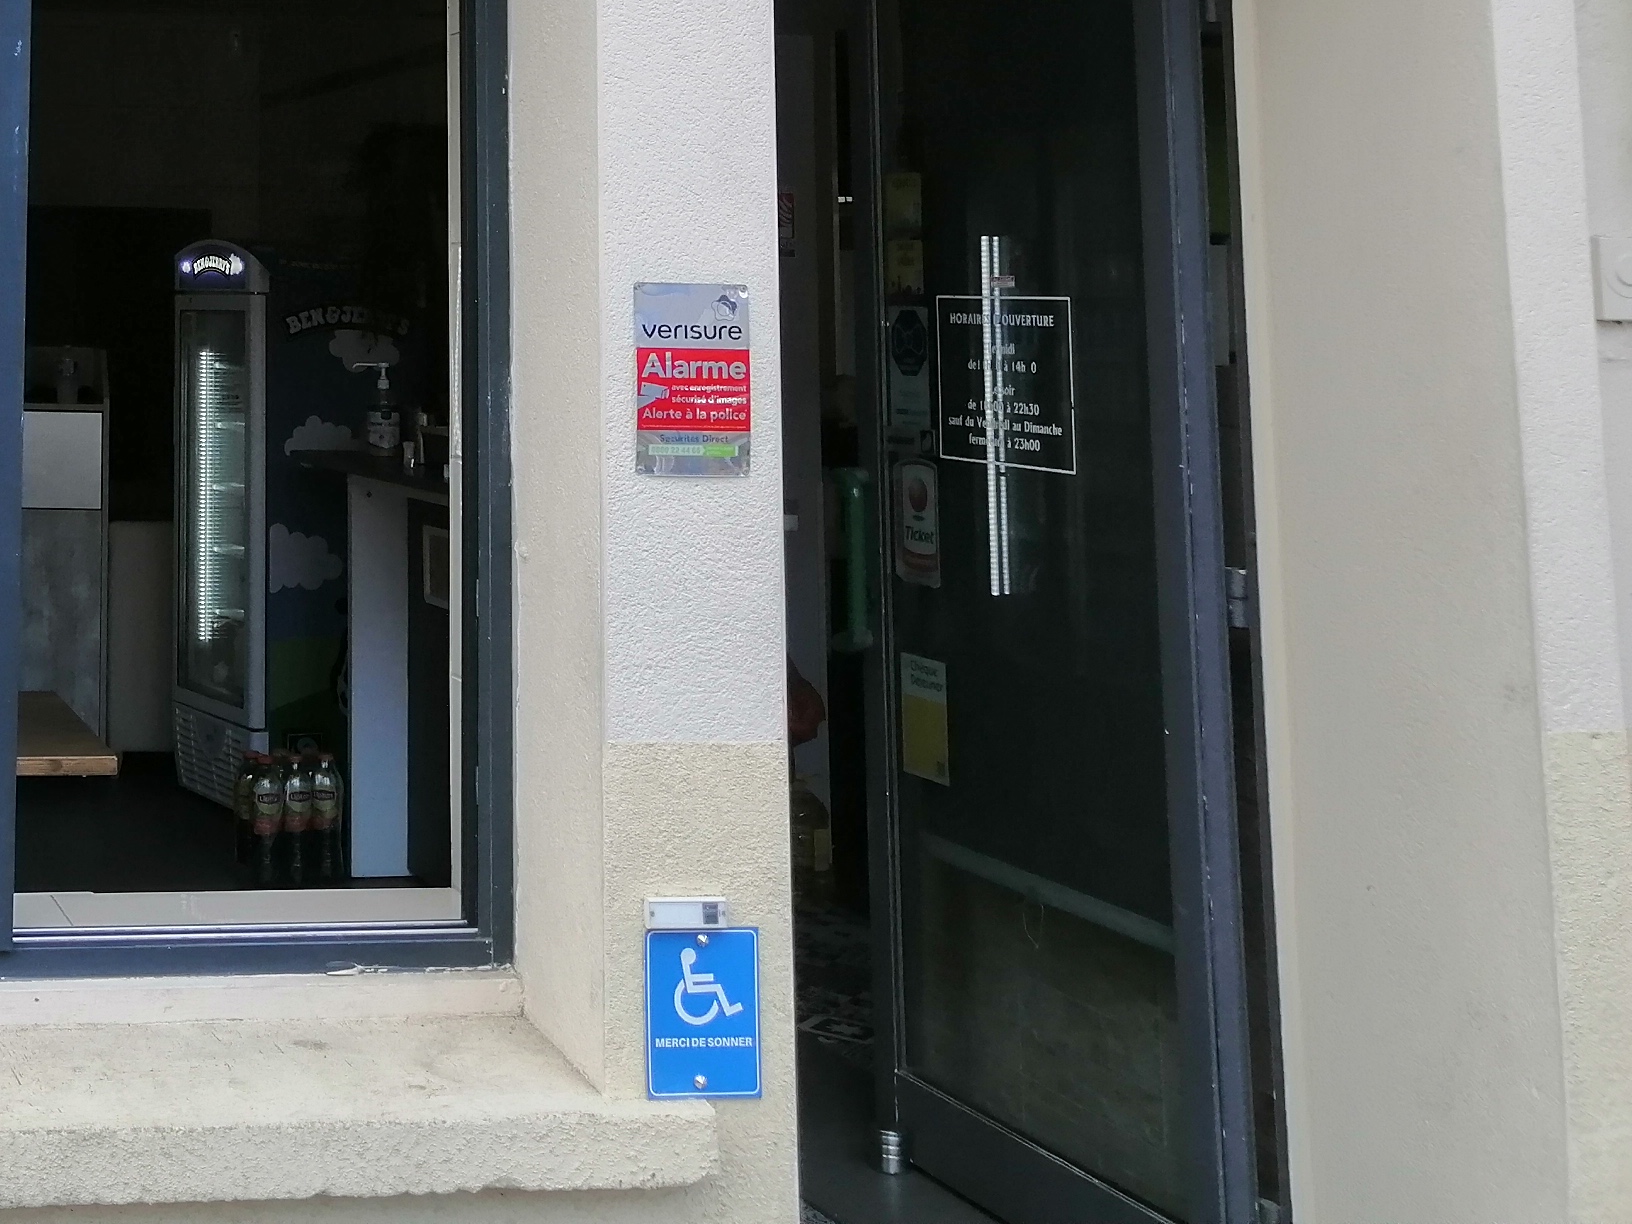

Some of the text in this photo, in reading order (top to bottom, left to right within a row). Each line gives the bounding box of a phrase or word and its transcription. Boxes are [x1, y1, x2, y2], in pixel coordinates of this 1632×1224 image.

[642, 323, 743, 340] verisure
[641, 351, 747, 380] Alarme
[689, 384, 747, 394] enregistrement
[671, 394, 747, 406] sécurisé d'images
[643, 408, 747, 423] Alerte à la police
[1013, 402, 1040, 416] 22h30
[948, 415, 963, 426] sauf
[965, 416, 974, 427] du
[1012, 422, 1022, 432] au
[1024, 421, 1063, 436] Dimanche
[702, 434, 729, 444] Direct
[1014, 438, 1041, 451] 23h00
[905, 525, 934, 544] Ticket
[655, 1037, 753, 1048] MERCI DE SONNER
